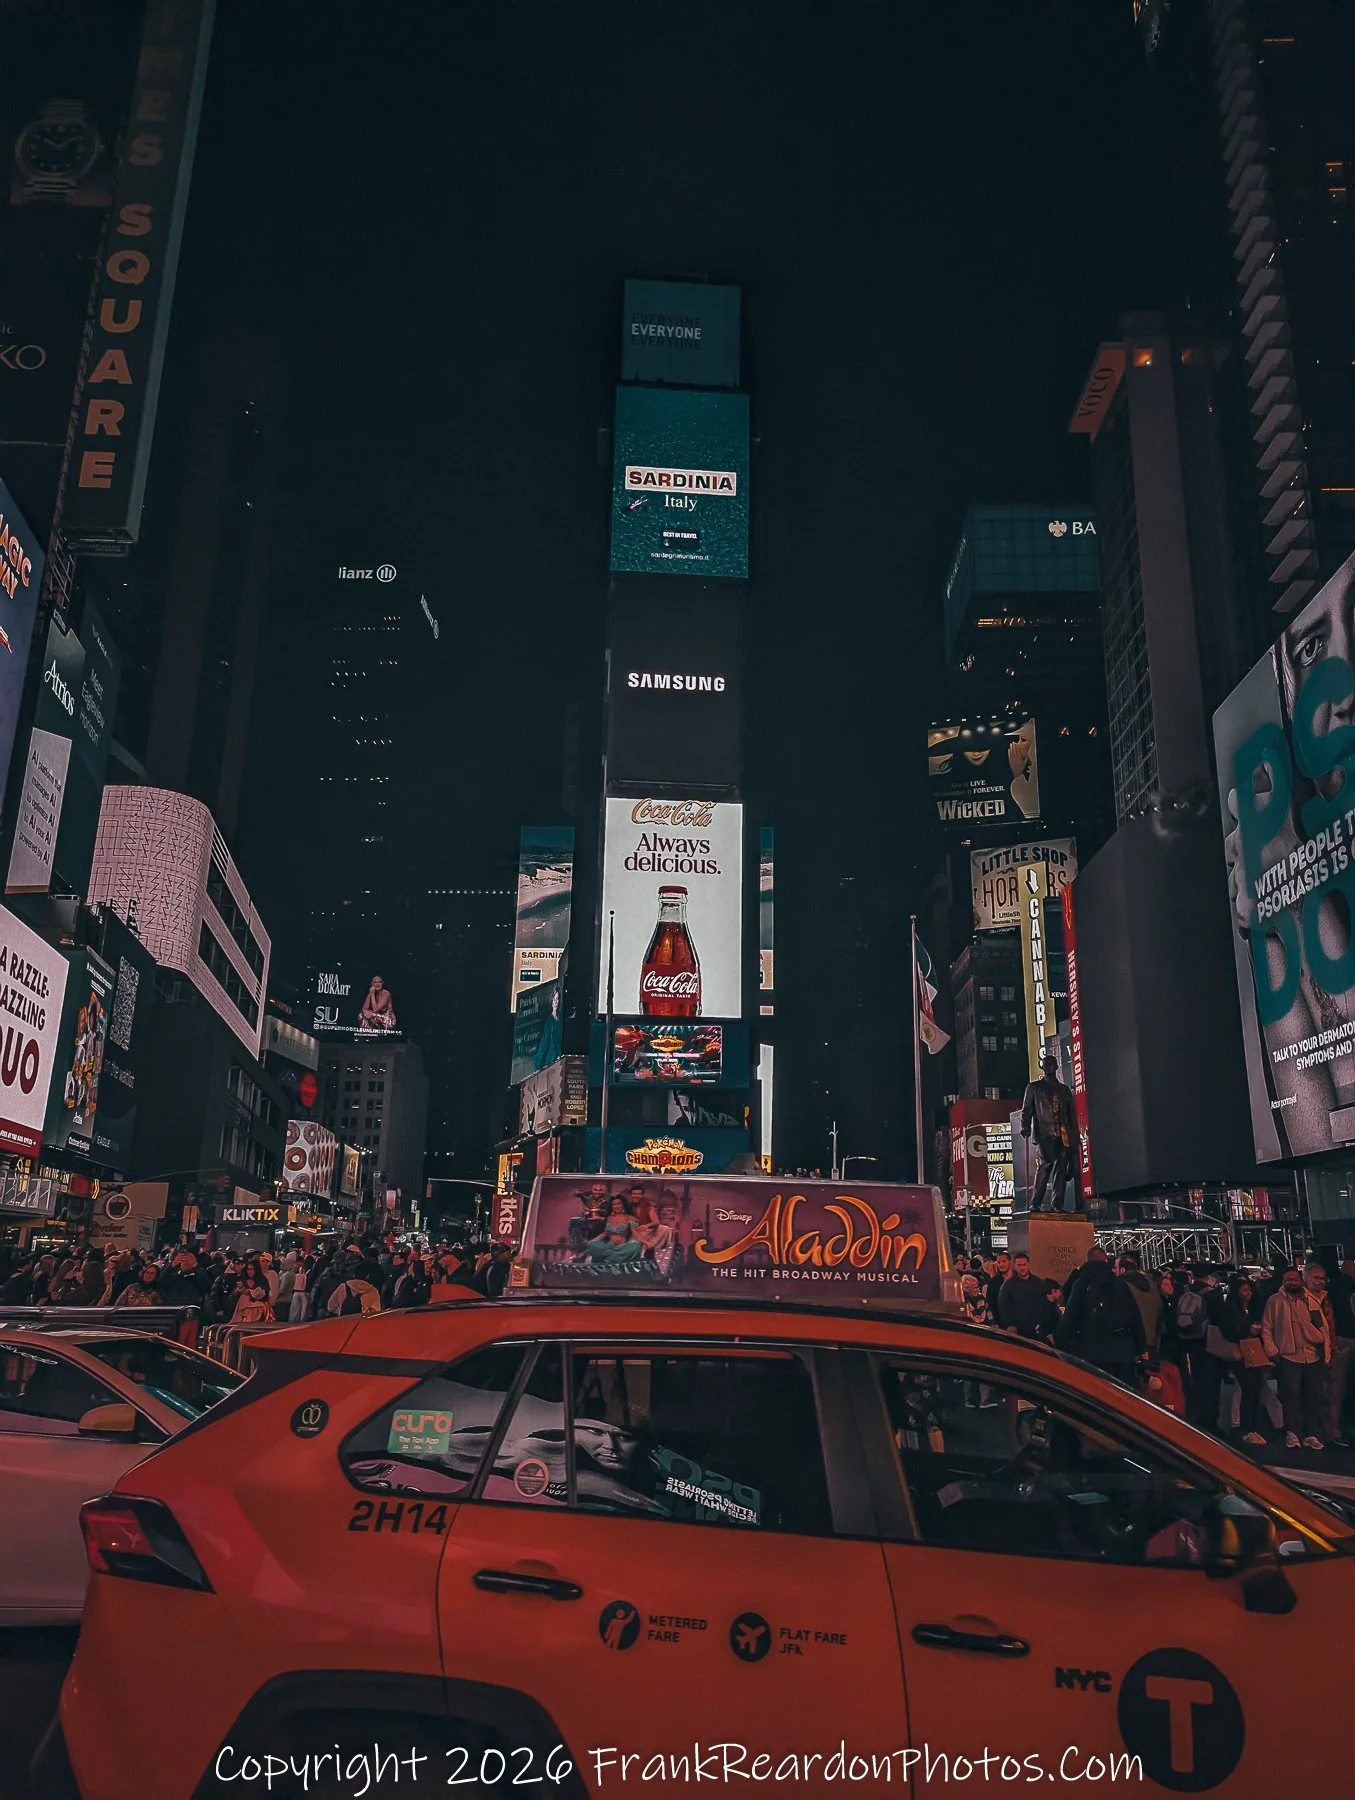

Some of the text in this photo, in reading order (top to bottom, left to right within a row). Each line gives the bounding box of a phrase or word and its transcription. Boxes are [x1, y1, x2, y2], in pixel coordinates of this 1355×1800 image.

[631, 323, 702, 340] EVERYONE
[78, 203, 153, 488] SQUARE
[629, 471, 733, 491] SARDINIA
[664, 494, 698, 512] Italy
[1072, 521, 1097, 535] BA
[44, 660, 75, 716] Atrios
[627, 672, 726, 693] SAMSUNG
[31, 750, 39, 766] AI
[50, 792, 56, 807] AI
[49, 812, 55, 828] AI
[631, 798, 717, 827] Coca-Cola
[29, 814, 36, 830] AI
[45, 829, 52, 846] AI
[636, 832, 711, 857] Always
[1254, 806, 1355, 899] WITH PEOPLE T
[43, 850, 50, 866] AI
[624, 851, 722, 875] delicious.
[982, 846, 1068, 876] LITTLE SHOP
[1257, 845, 1348, 923] PSORIASIS IS
[317, 980, 351, 996] DUKART
[319, 973, 339, 985] SARA
[643, 970, 699, 994] Coca-Cola
[0, 984, 46, 1031] AZZLING
[314, 1006, 339, 1023] SU
[1067, 949, 1083, 1096] HERSHEY'S STORE
[0, 1025, 40, 1095] UO
[1273, 1047, 1289, 1063] TALK
[1289, 1045, 1298, 1057] TO
[1299, 1036, 1319, 1054] YOUR
[1296, 1041, 1352, 1070] SYMPTOMS AND
[223, 1208, 279, 1221] KLIKTIX
[498, 1197, 518, 1235] tkts
[695, 1195, 927, 1271] Aladdin
[712, 1267, 918, 1283] THE HIT BROADWAY MUSICAL
[392, 1412, 452, 1433] curb
[348, 1500, 448, 1535] 2H14
[649, 1615, 707, 1630] METERED
[647, 1630, 680, 1643] FARE
[780, 1628, 847, 1645] FLAT FARE
[779, 1642, 804, 1656] JFK
[1055, 1666, 1112, 1693] NYC
